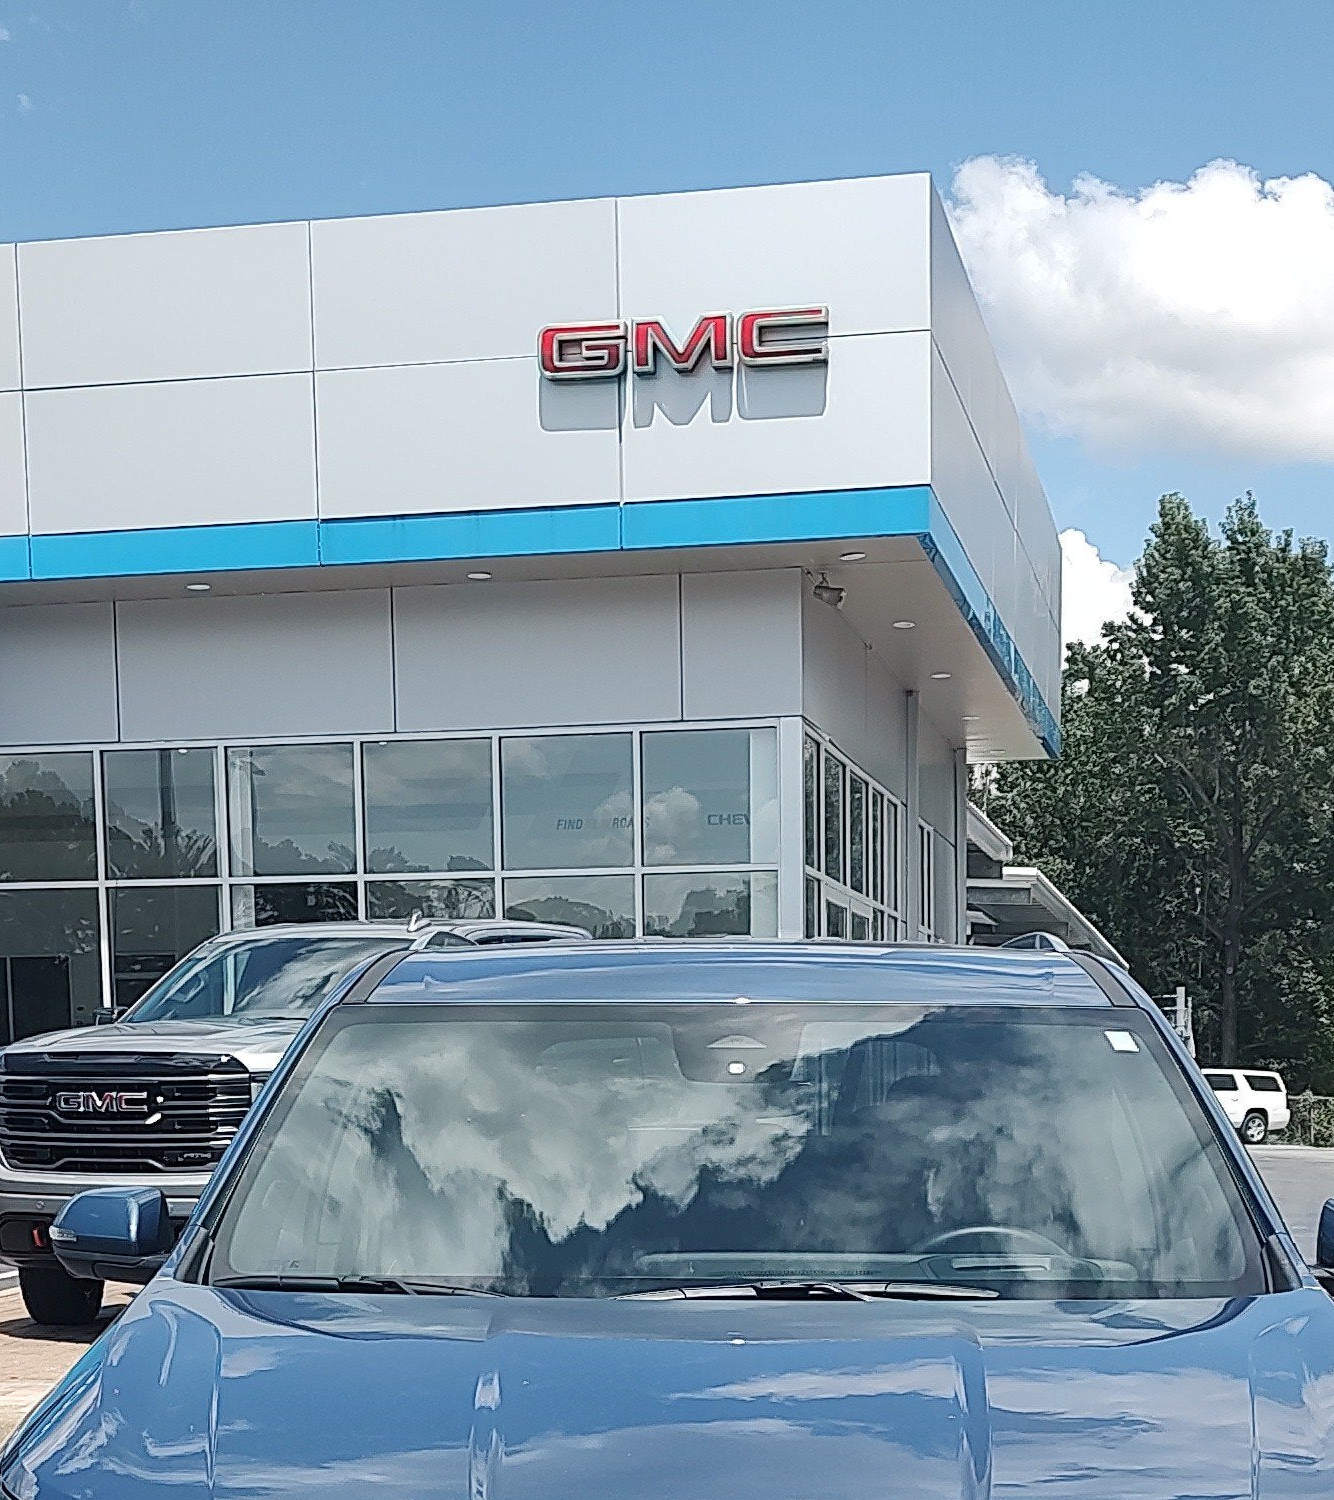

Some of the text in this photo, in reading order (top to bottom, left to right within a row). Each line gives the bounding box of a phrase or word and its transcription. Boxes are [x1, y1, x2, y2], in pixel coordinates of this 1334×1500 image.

[538, 306, 828, 381] GMC
[556, 816, 650, 831] FIND ROAS
[56, 1091, 148, 1112] GMC
